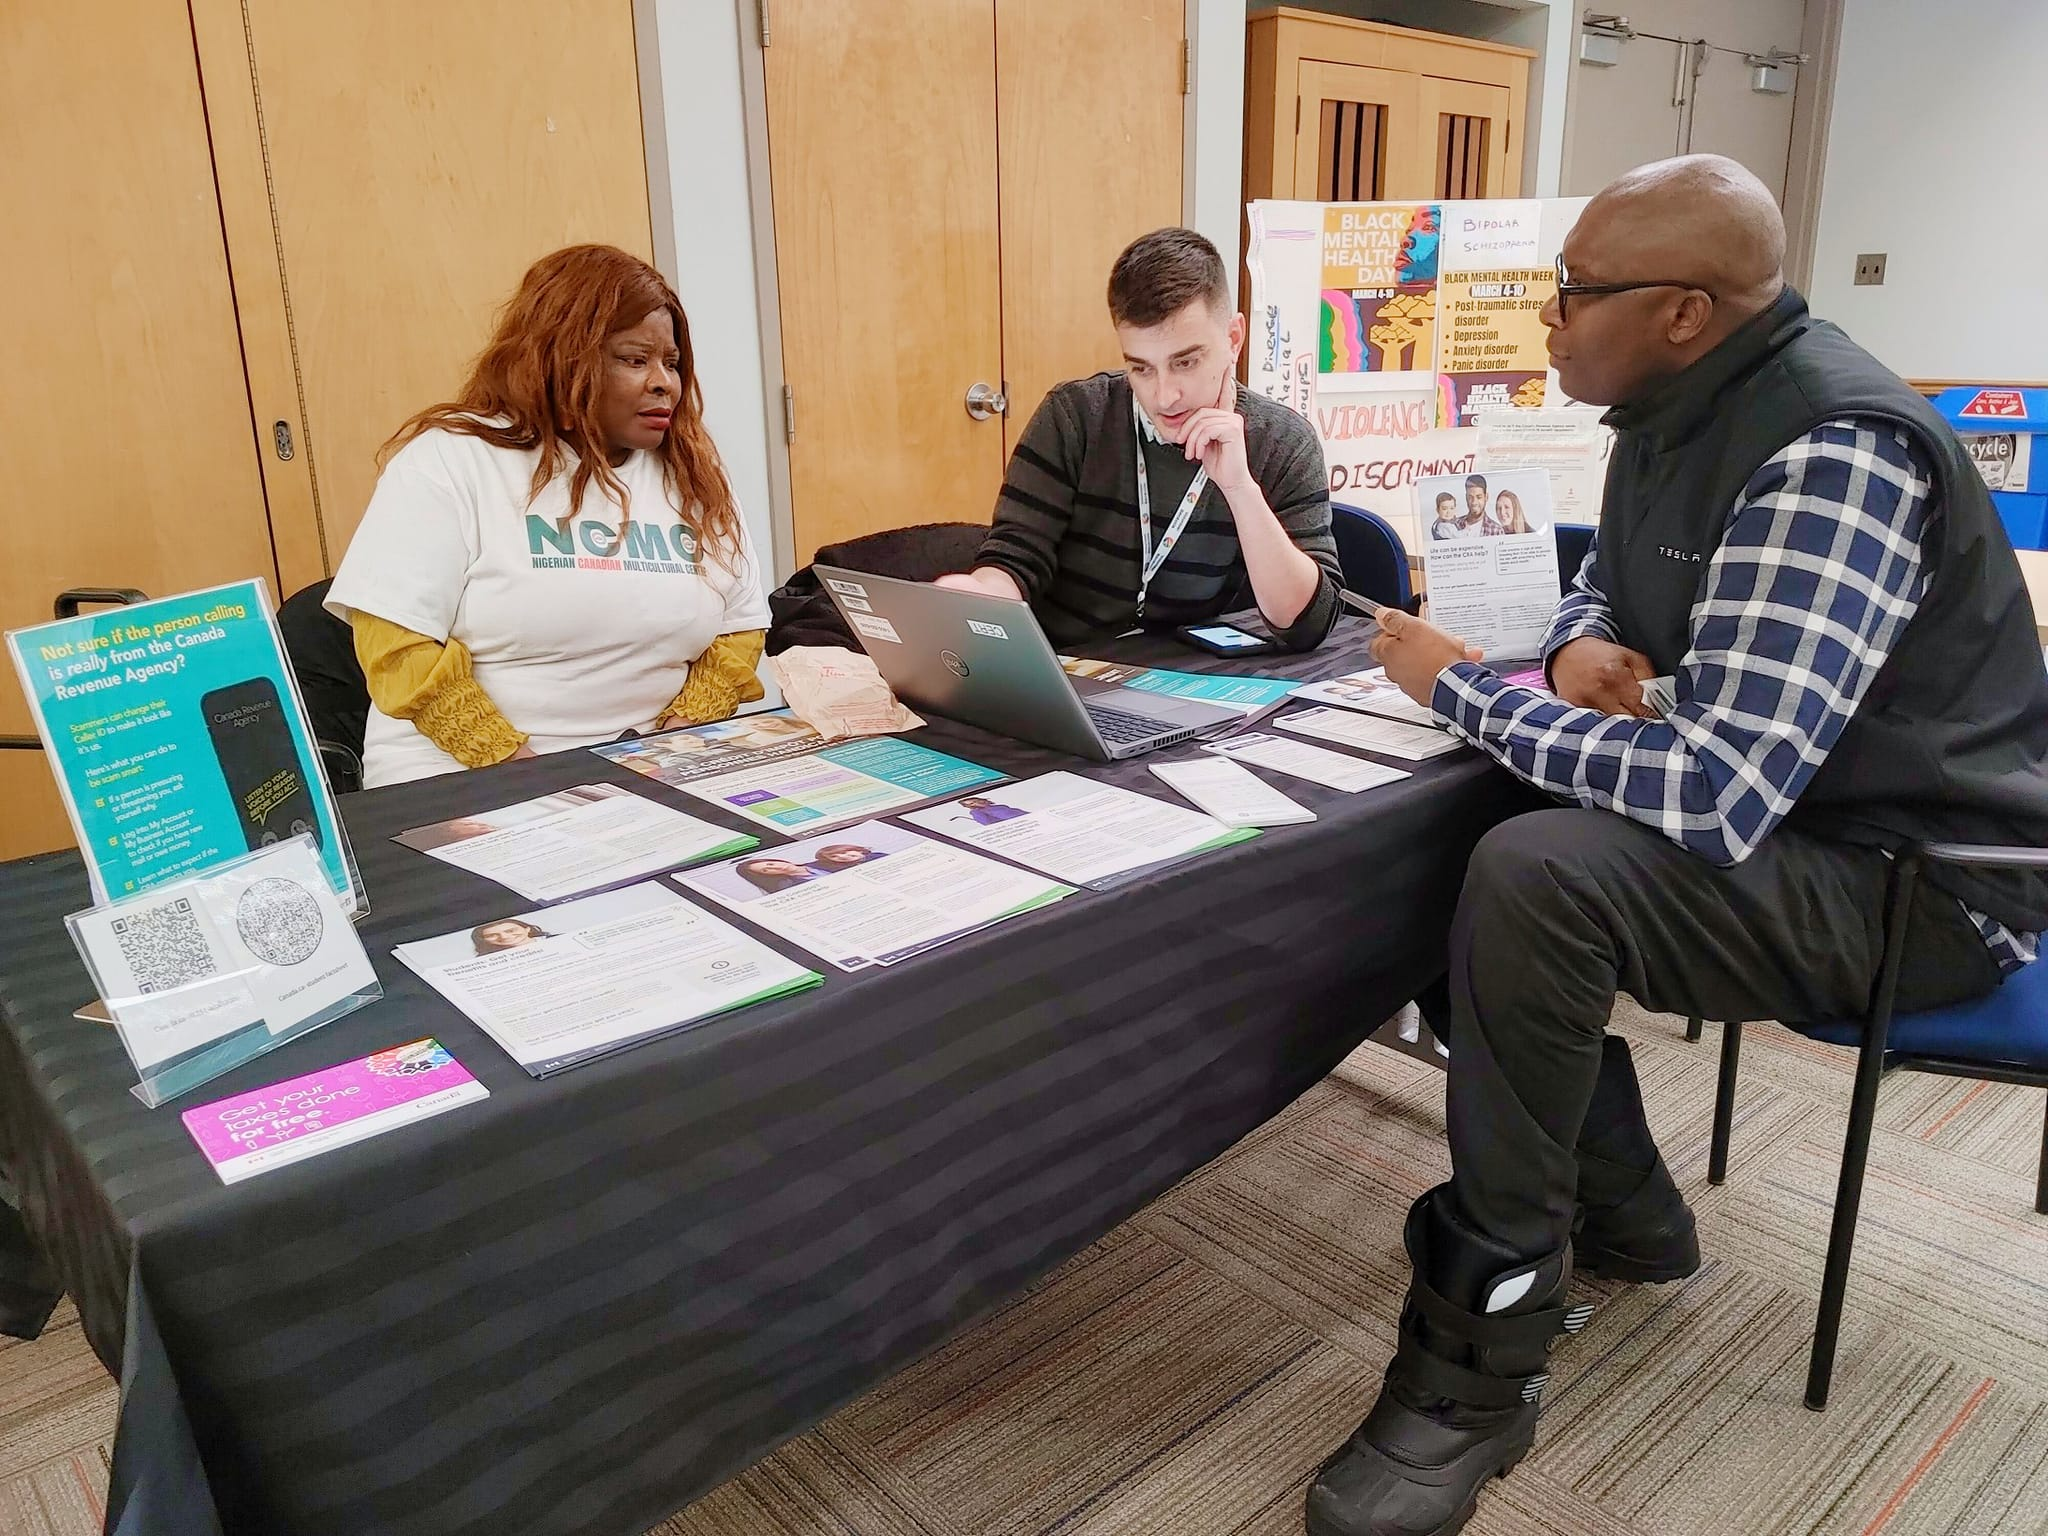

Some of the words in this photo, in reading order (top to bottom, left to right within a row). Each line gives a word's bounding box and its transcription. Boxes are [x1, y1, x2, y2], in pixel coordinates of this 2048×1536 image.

[1341, 212, 1405, 230] BLACK
[1323, 231, 1401, 249] MENTAL
[1323, 249, 1398, 266] HEALTH
[1358, 267, 1396, 284] DAY
[1444, 273, 1469, 283] BLACK
[1471, 272, 1500, 282] MENTAL
[1501, 271, 1529, 281] HEALTH
[1531, 271, 1554, 281] WEEK
[1471, 285, 1502, 298] MARCH
[1503, 284, 1524, 297] 4-10
[1519, 299, 1544, 310] stres
[1455, 315, 1489, 326] disorder
[1454, 330, 1498, 342] Depression
[1453, 345, 1482, 357] Anxiety
[1484, 343, 1518, 354] disorder
[1452, 360, 1473, 371] Panic
[1475, 358, 1509, 370] disorder
[1471, 384, 1509, 395] BLACK
[1317, 400, 1430, 440] VIOLENCE
[1330, 454, 1475, 492] DISCRIMINAT
[525, 514, 704, 563] NCMC
[1659, 546, 1701, 562] TESLA
[532, 556, 576, 569] NIGERIAN
[577, 558, 622, 571] CANADIAN
[623, 560, 685, 574] MULTICULTURAL
[41, 644, 74, 661] Not
[78, 638, 110, 652] sure
[112, 631, 125, 644] if
[126, 627, 151, 642] the
[154, 615, 201, 638] person
[204, 605, 245, 623] calling
[49, 667, 63, 681] is
[68, 656, 107, 677] really
[109, 648, 146, 665] from
[149, 641, 173, 655] the
[175, 626, 226, 648] Canada
[55, 674, 122, 701] Revenue
[126, 655, 186, 683] Agency?
[70, 718, 109, 733] Scammers
[109, 713, 123, 721] can
[124, 706, 150, 717] change
[215, 710, 242, 723] Canada
[242, 701, 271, 714] Revenue
[97, 729, 106, 737] ID
[107, 726, 116, 734] to
[117, 721, 137, 731] make
[144, 713, 160, 722] look
[234, 715, 260, 728] Agency
[809, 735, 826, 744] PO
[111, 759, 130, 770] what
[130, 754, 145, 765] you
[144, 751, 157, 759] can
[158, 746, 168, 754] do
[168, 743, 177, 751] to
[680, 755, 768, 777] PERSONNES
[768, 740, 826, 758] HANDICA
[121, 788, 144, 802] person
[245, 787, 264, 803] LISTEN
[263, 781, 272, 790] TO
[273, 771, 288, 784] YOUR
[247, 795, 266, 810] VOICE
[264, 789, 273, 797] OF
[273, 773, 296, 792] REASON
[112, 805, 120, 813] or
[251, 800, 271, 818] BEFORE
[272, 790, 284, 801] YOU
[218, 1101, 267, 1121] Get
[273, 1083, 325, 1106] your
[224, 1107, 290, 1132] taxes
[297, 1085, 361, 1110] done
[229, 1125, 265, 1143] for
[271, 1109, 330, 1130] free.
